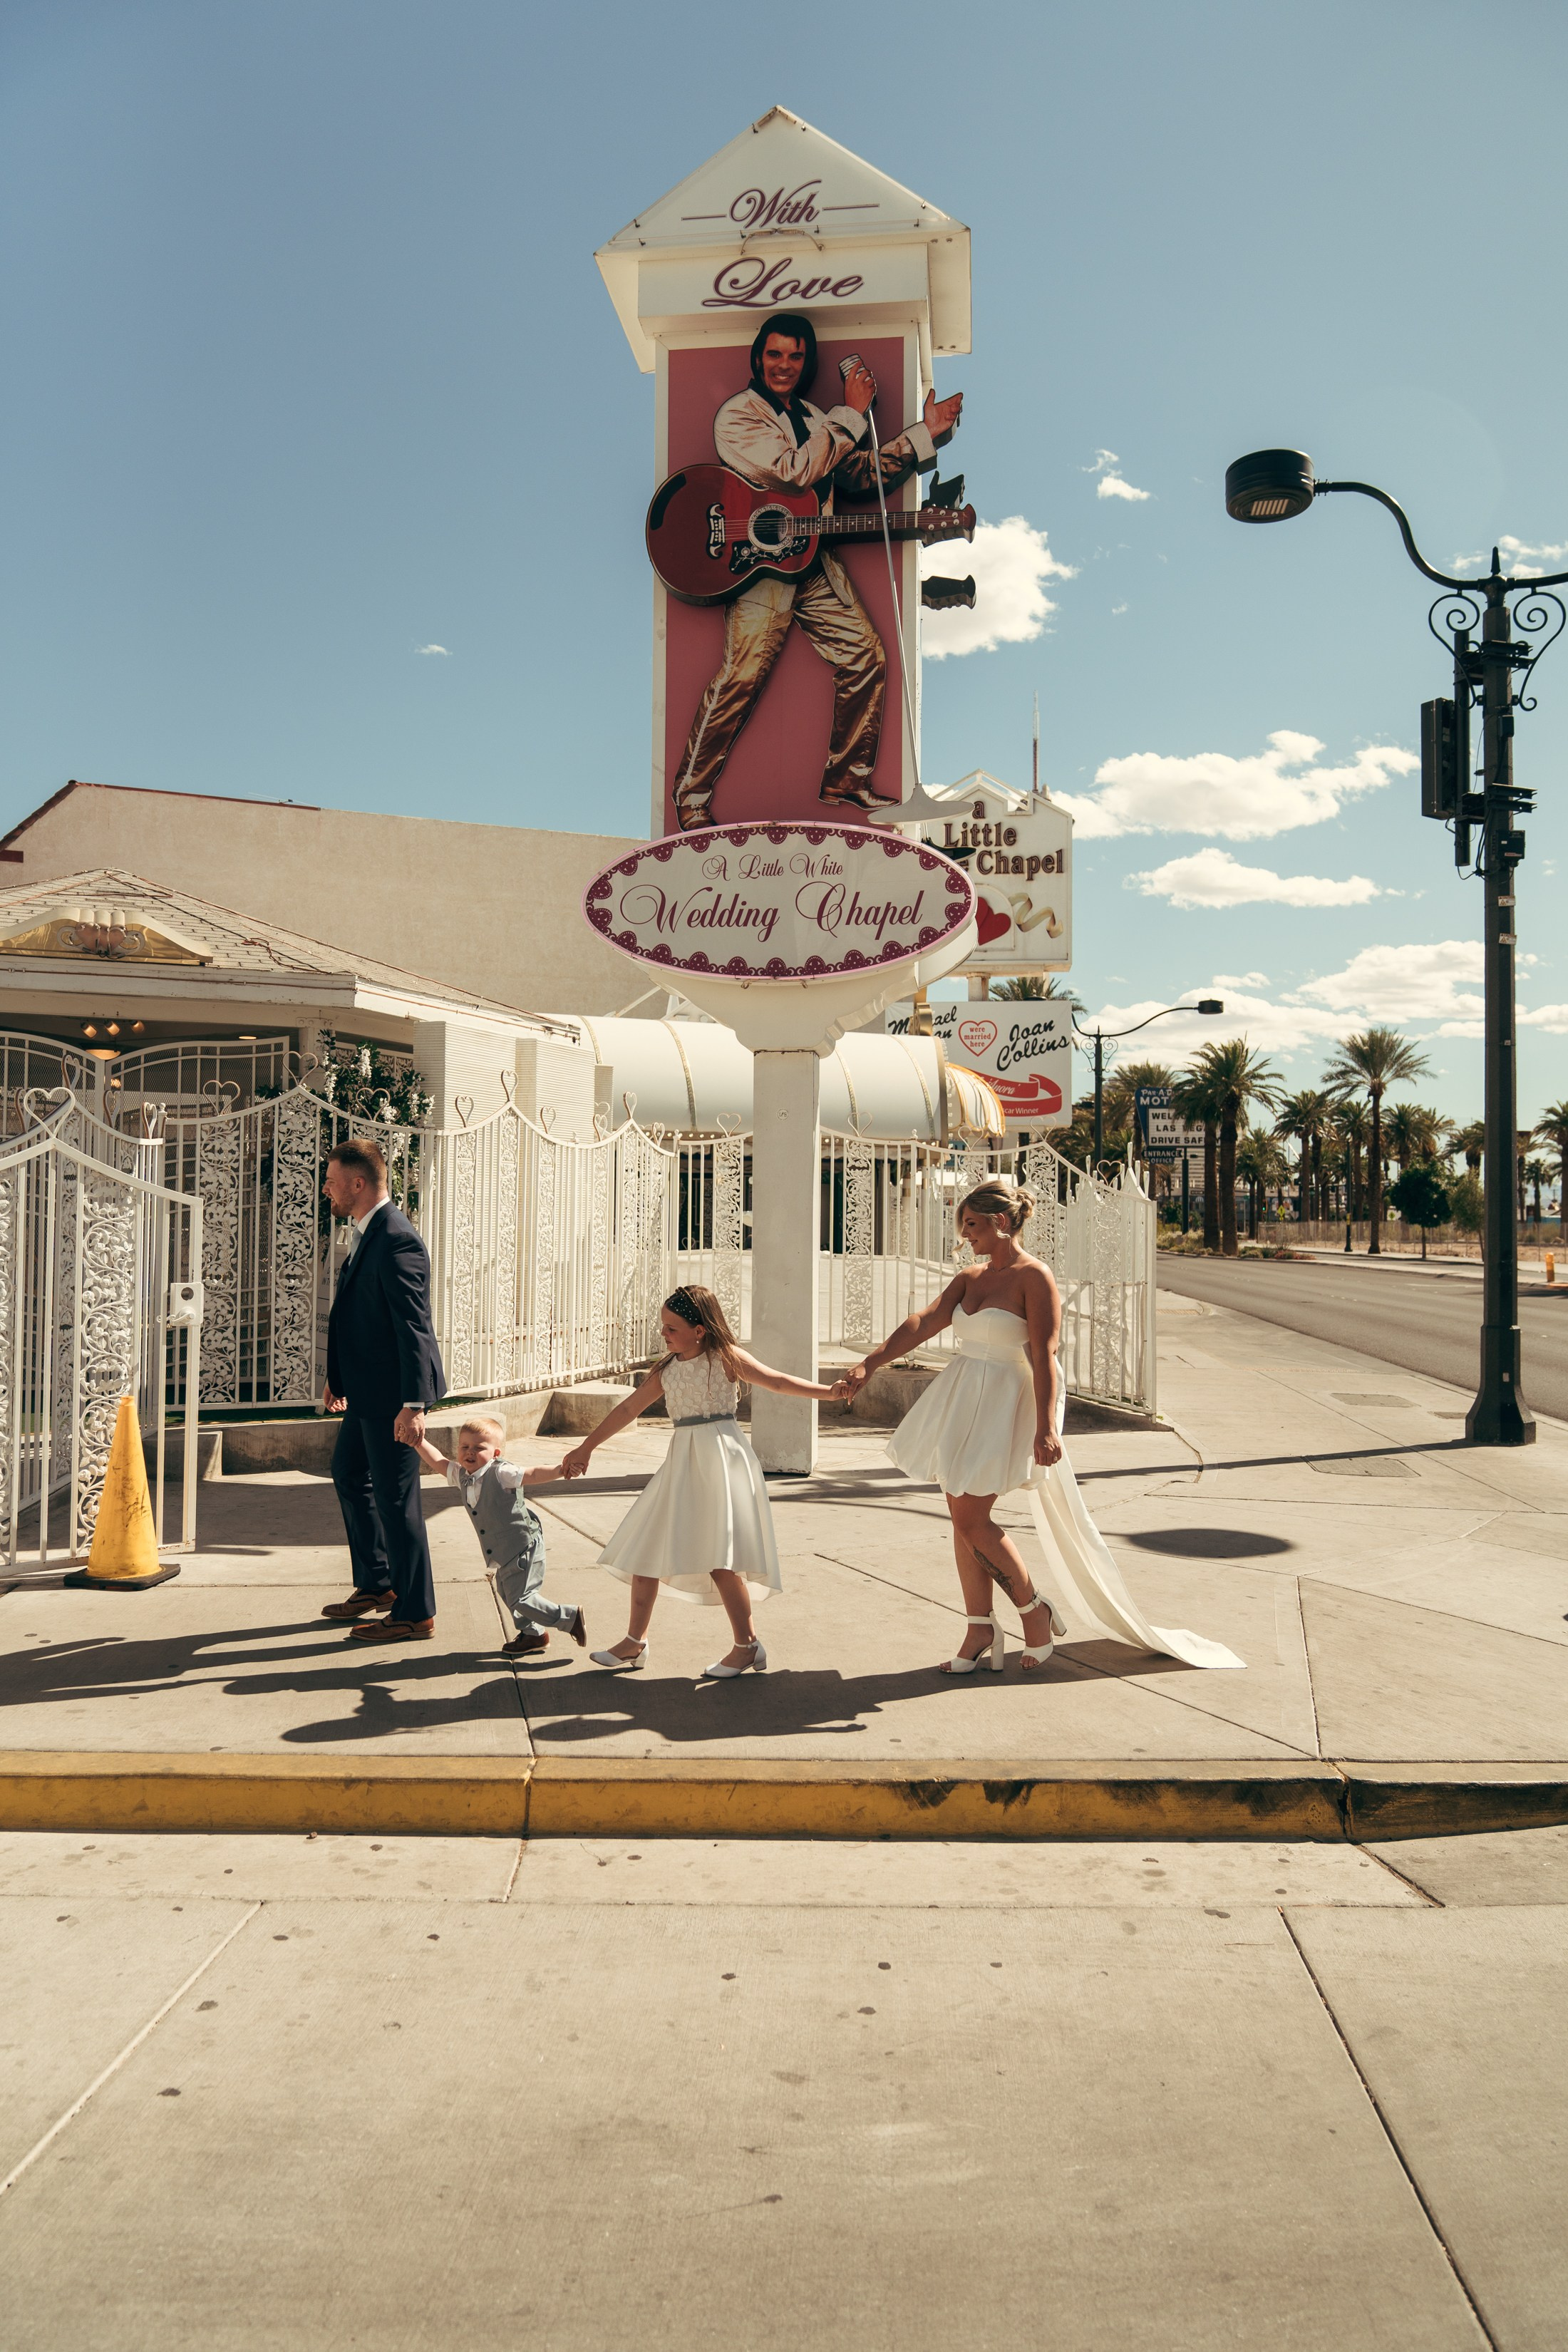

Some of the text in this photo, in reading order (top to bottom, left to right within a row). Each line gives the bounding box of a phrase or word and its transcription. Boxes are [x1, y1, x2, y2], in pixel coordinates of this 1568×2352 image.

[730, 180, 822, 228] With
[701, 257, 864, 308] Love
[972, 800, 985, 819] a
[944, 822, 1017, 847] Little
[702, 853, 843, 881] A Little White
[976, 848, 1063, 881] Chapel
[620, 881, 924, 942] Wedding Chapel
[1009, 1019, 1055, 1051] Joan
[996, 1035, 1071, 1071] Collins
[1140, 1096, 1170, 1105] MOT
